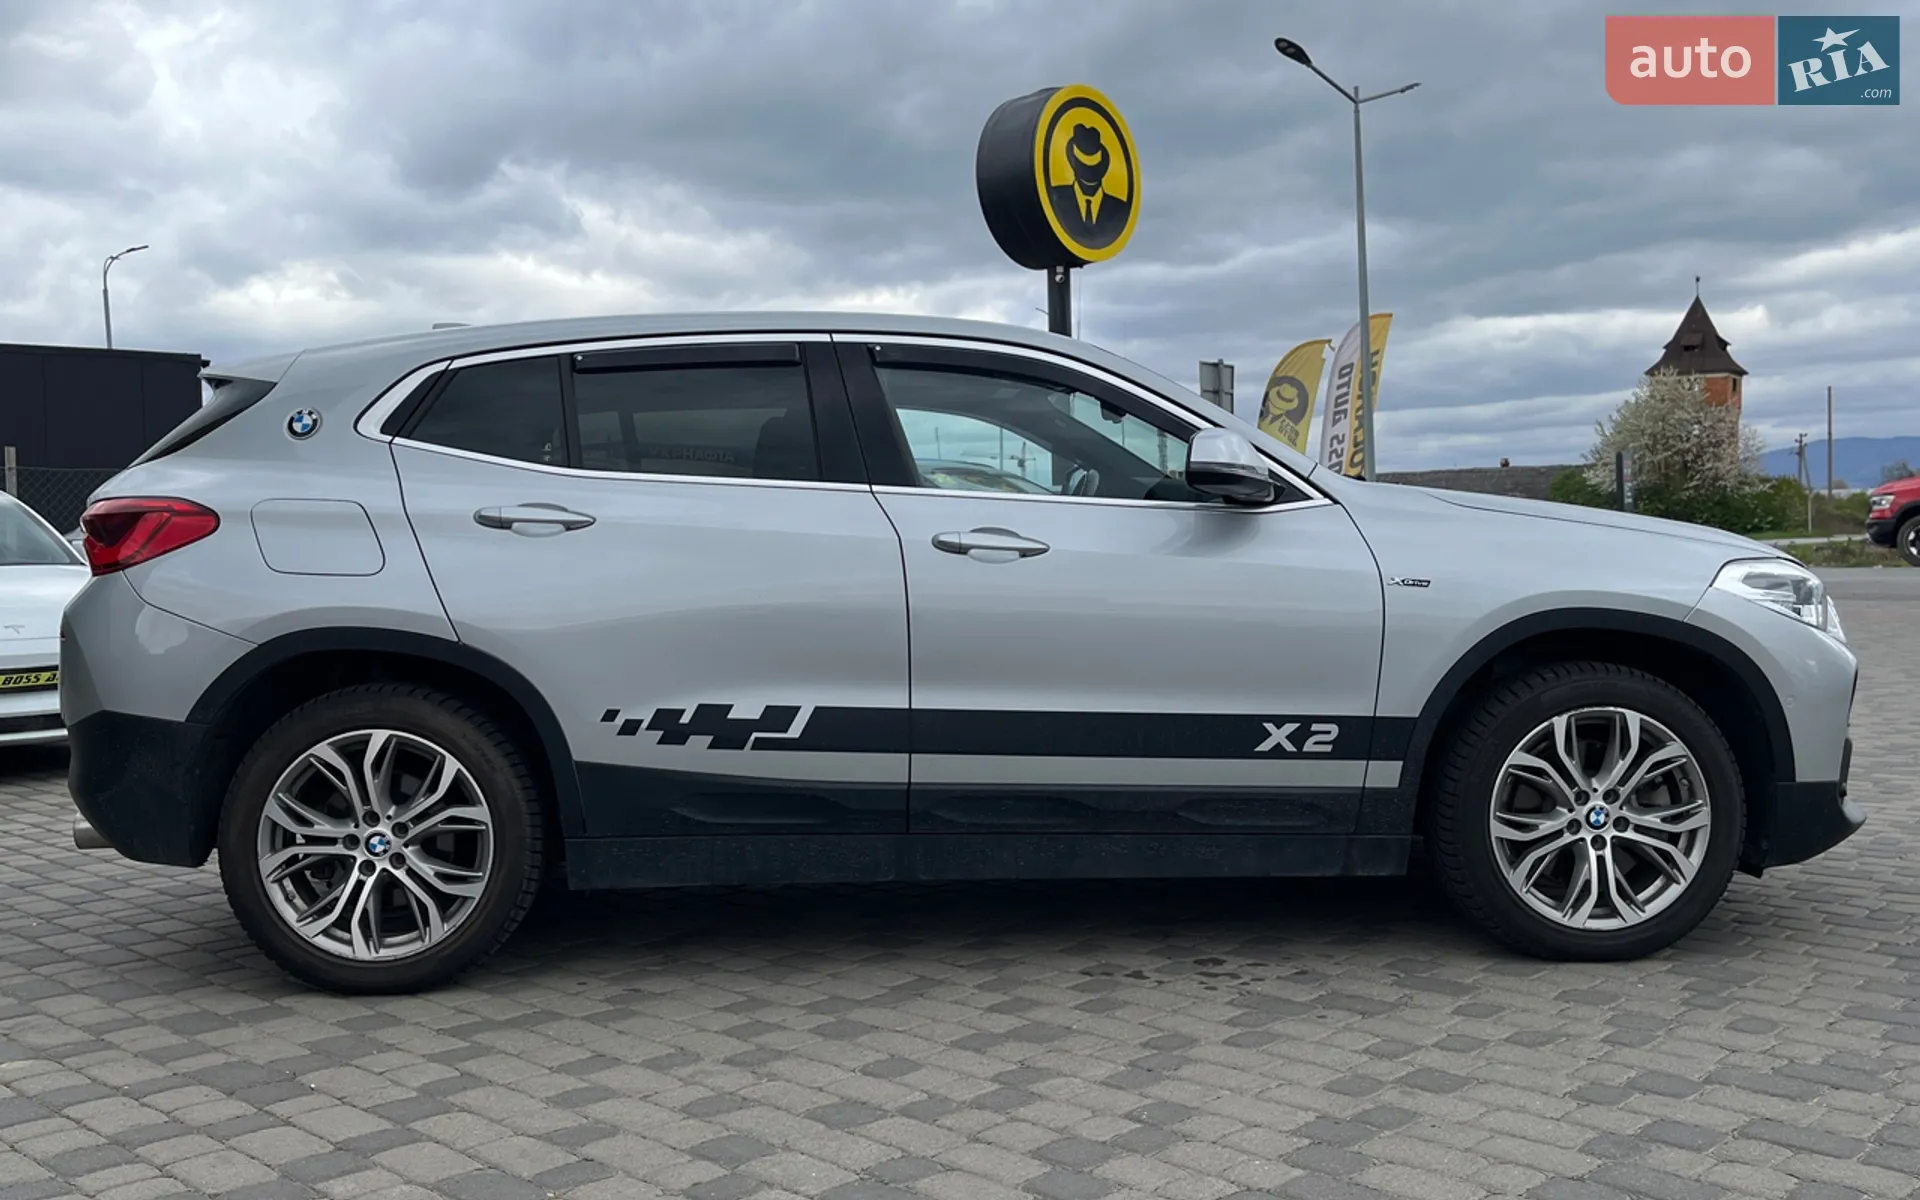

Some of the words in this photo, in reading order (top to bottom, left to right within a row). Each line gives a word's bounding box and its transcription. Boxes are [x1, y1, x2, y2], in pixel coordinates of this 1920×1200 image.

[2, 673, 42, 686] BOSS
[45, 672, 59, 682] A
[1254, 722, 1340, 752] X2
